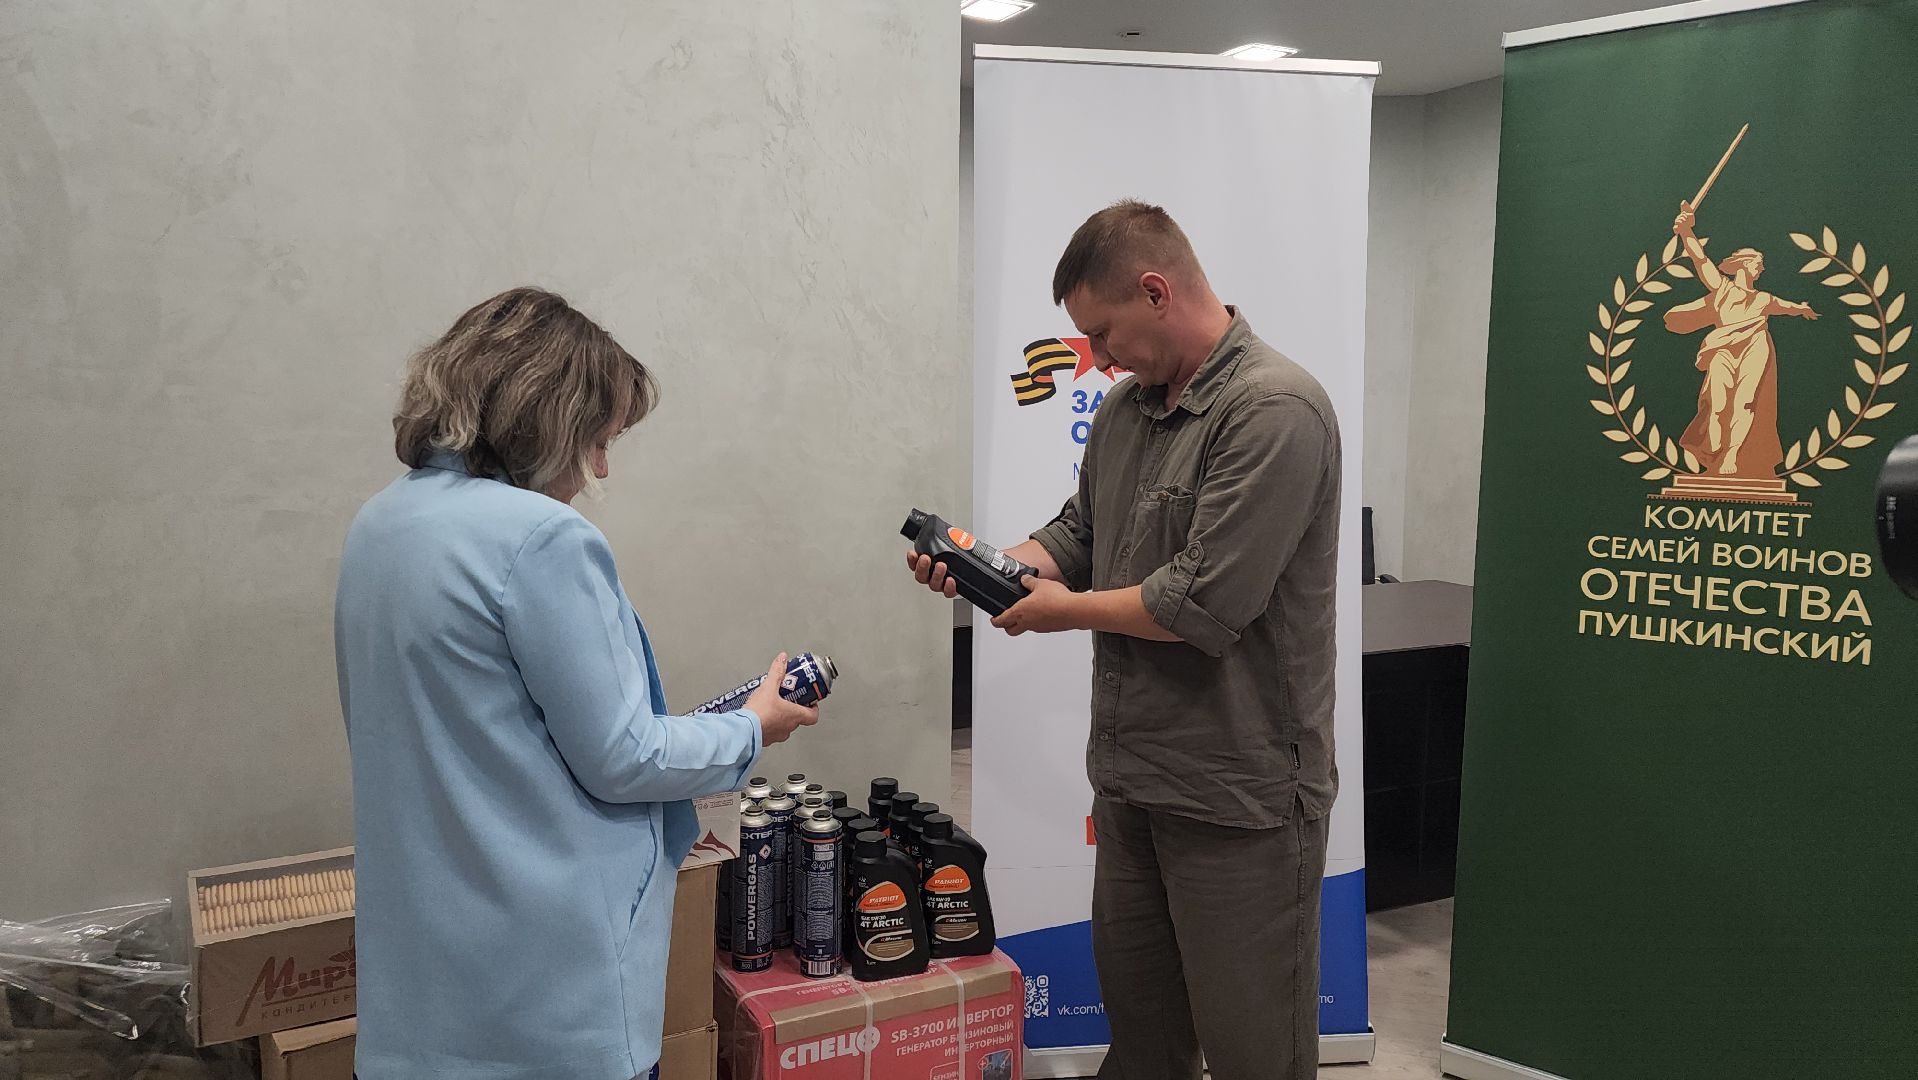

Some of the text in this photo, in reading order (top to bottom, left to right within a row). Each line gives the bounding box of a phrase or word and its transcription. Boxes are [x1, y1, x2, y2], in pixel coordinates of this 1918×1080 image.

[1644, 505, 1812, 538] КОМИТЕТ
[1587, 535, 1872, 578] СЕМЕЙ ВОИНОВ
[1580, 567, 1872, 626] ОТЕЧЕСТВА
[1578, 609, 1872, 666] ПУШКИНСКИЙ
[747, 853, 757, 941] POWERGAS
[937, 901, 969, 909] ARCTIC
[860, 917, 904, 928] 4T ARCTIC
[891, 1004, 1014, 1044] SB-3700 ИВЕРТОР
[896, 1036, 948, 1057] ГЕНЕРАТОР
[944, 1032, 1013, 1057] ИНЕРТОРНЫЙ
